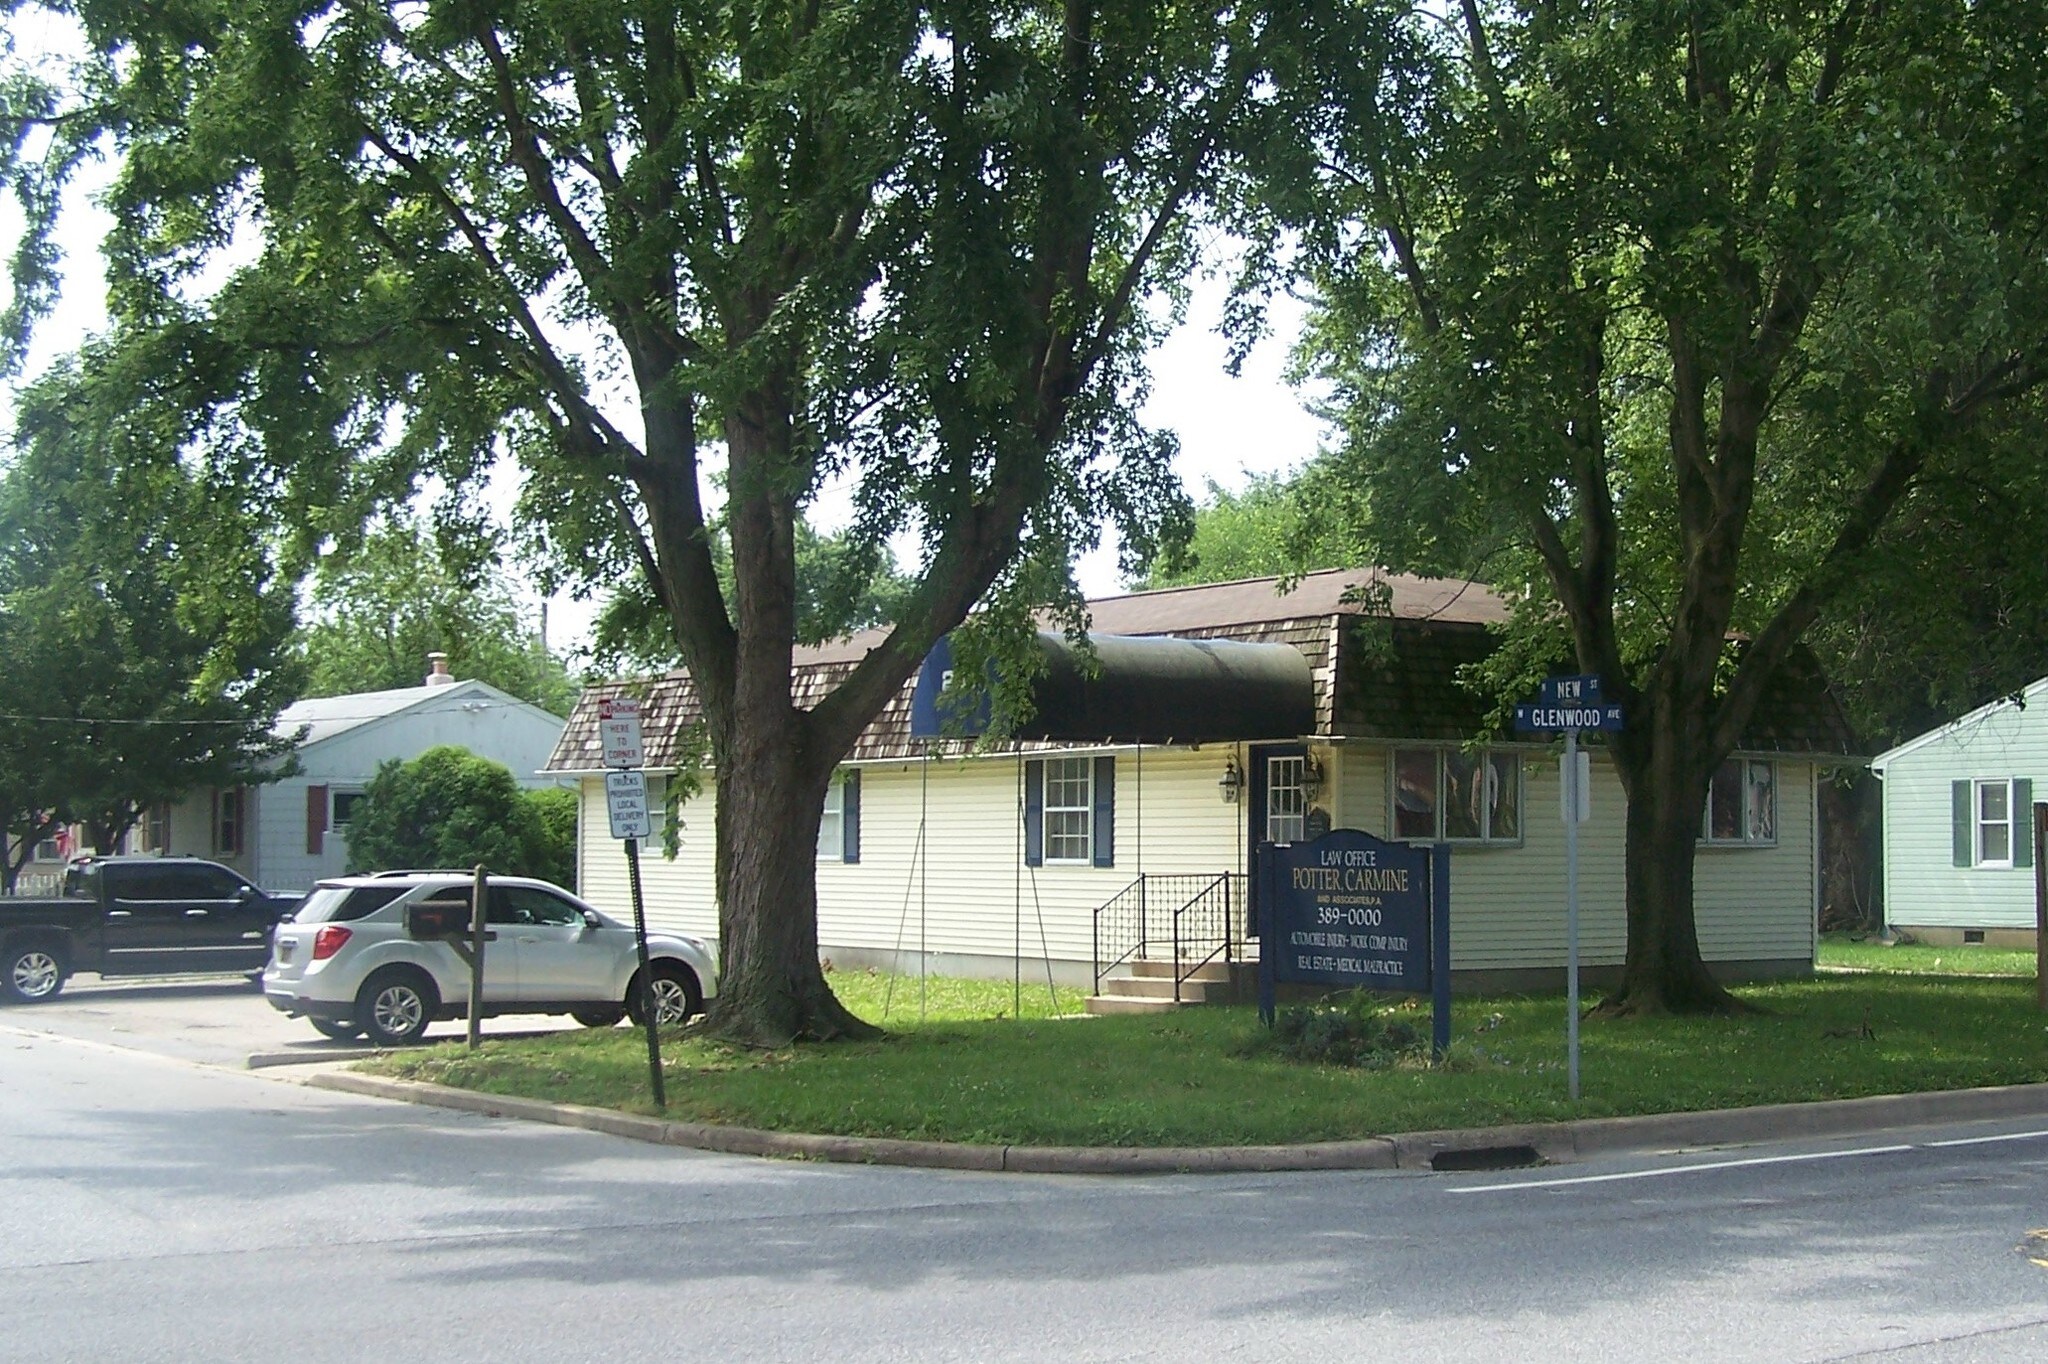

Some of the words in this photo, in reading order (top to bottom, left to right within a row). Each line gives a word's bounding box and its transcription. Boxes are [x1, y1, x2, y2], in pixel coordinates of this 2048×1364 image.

[1557, 680, 1581, 699] NEW
[1589, 679, 1598, 690] ST
[1532, 708, 1600, 727] GLENWOOD
[1607, 708, 1620, 719] AVE
[610, 723, 630, 734] HERE
[617, 736, 628, 747] TO
[608, 749, 637, 759] CORNER
[613, 777, 639, 787] TRUCKS
[610, 788, 644, 798] PROHIBITED
[617, 800, 638, 810] LOCAL
[613, 811, 645, 822] DELIVERY
[621, 823, 639, 833] ONLY
[1321, 850, 1342, 866] LAW
[1344, 850, 1377, 866] OFFICE
[1292, 867, 1344, 893] POTTER,
[1345, 868, 1409, 892] CARMINE
[1317, 895, 1331, 904] AND
[1317, 907, 1382, 926] 389-0000
[1350, 934, 1367, 949] WORK
[1298, 955, 1312, 969] REAL
